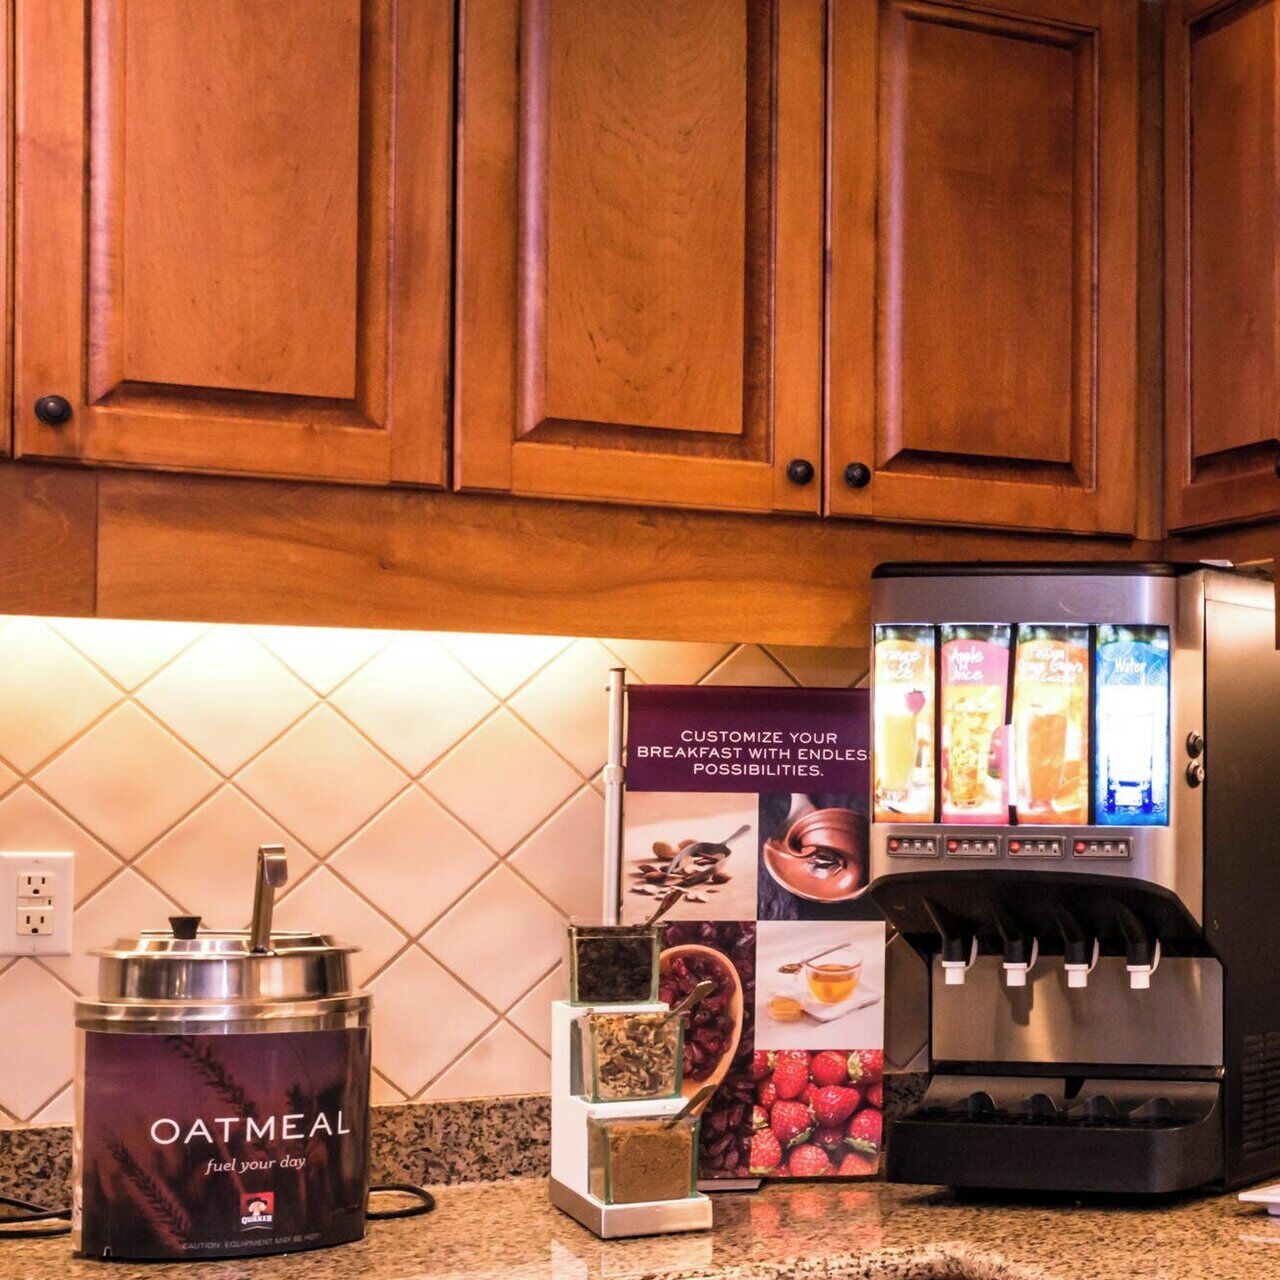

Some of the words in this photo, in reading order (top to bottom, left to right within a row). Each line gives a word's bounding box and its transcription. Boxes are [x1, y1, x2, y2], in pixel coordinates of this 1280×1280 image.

[949, 645, 985, 668] Apple
[1114, 656, 1147, 675] Water
[948, 667, 985, 682] Juice
[680, 730, 784, 743] CUSTOMIZE
[789, 732, 838, 745] YOUR
[637, 746, 743, 759] BREAKFAST
[748, 747, 791, 760] WITH
[693, 763, 824, 777] POSSIBILITIES.
[150, 1110, 350, 1145] OATMEAL
[204, 1158, 236, 1175] fuel
[239, 1159, 276, 1174] your
[279, 1154, 306, 1169] day
[241, 1214, 273, 1225] QUAKER
